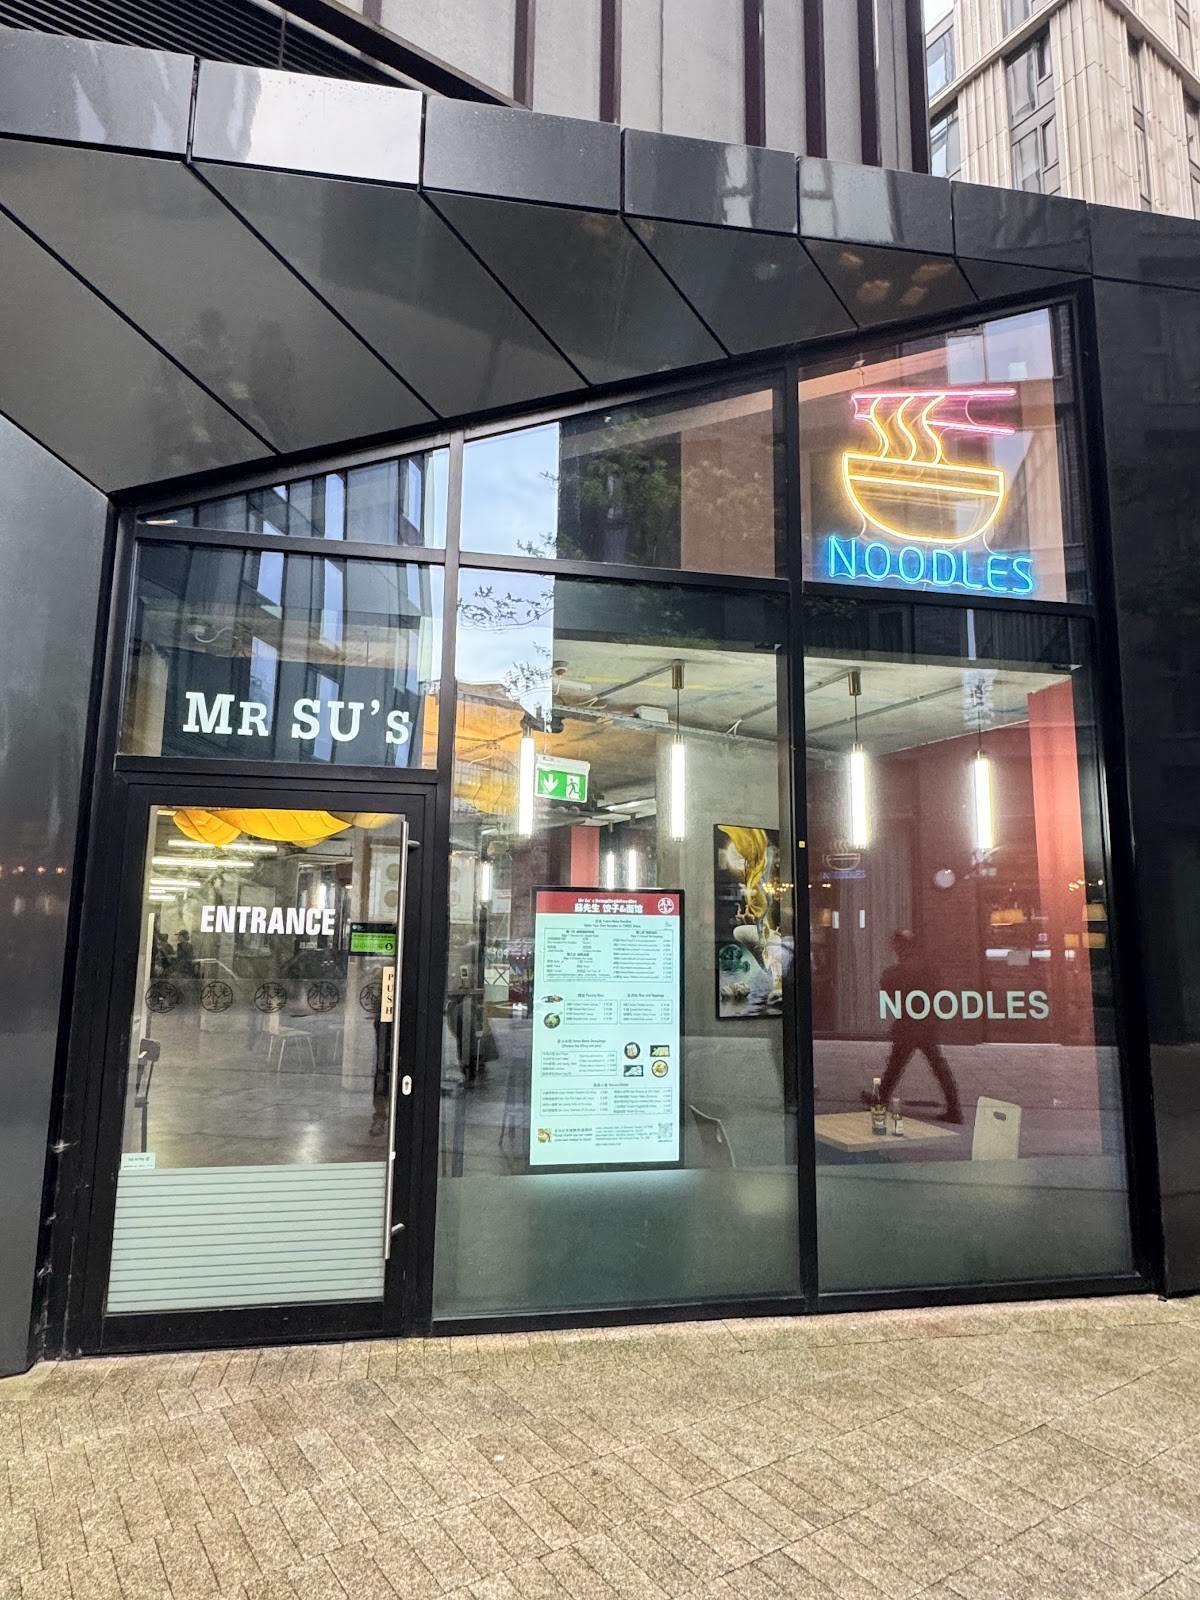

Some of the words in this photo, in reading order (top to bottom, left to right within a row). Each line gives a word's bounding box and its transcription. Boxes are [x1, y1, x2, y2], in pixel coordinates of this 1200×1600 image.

[828, 535, 1034, 593] NOODLES
[200, 905, 336, 936] ENTRANCE
[385, 973, 394, 1015] PUSH
[879, 990, 1050, 1020] NOODLES
